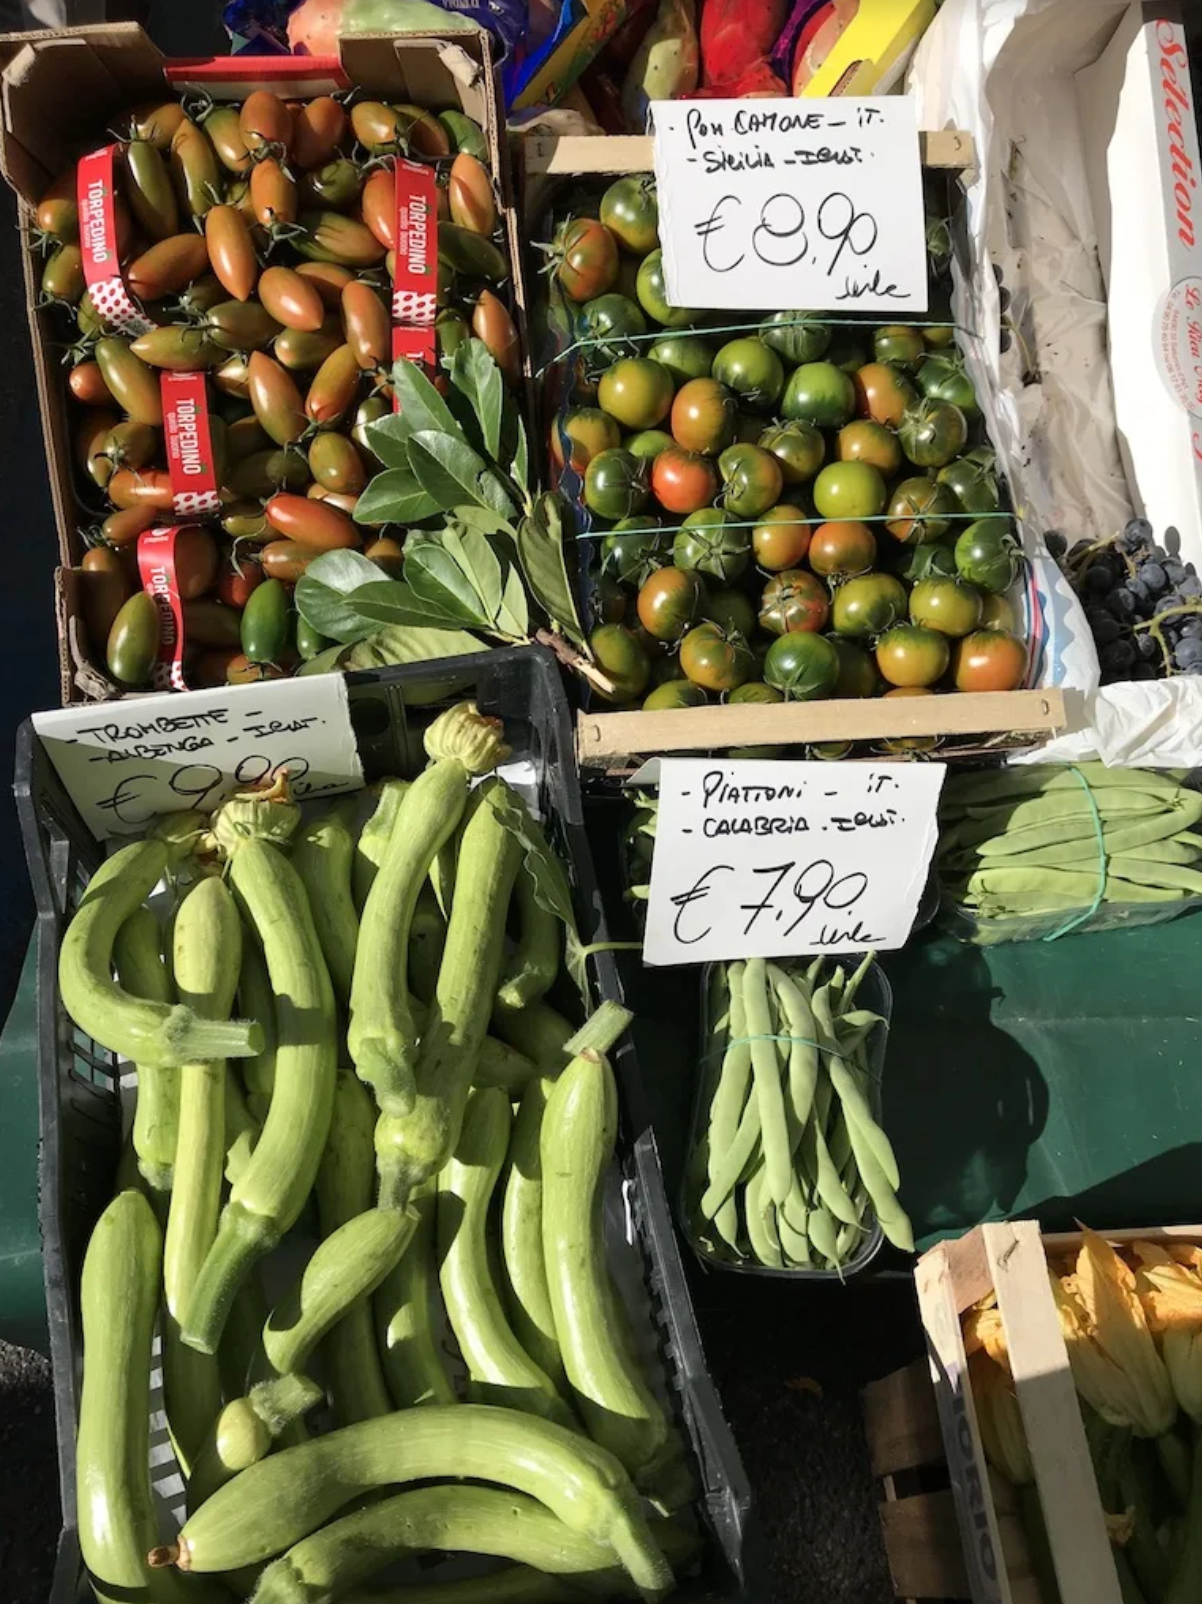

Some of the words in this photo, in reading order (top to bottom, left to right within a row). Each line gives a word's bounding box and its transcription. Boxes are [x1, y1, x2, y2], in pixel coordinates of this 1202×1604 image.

[1155, 18, 1197, 252] Selection
[87, 179, 107, 263] TORPEDINO
[408, 194, 426, 275] TORPEDINO
[175, 398, 202, 475] TORPEDINO
[77, 708, 229, 744] TROMBETTE
[703, 771, 808, 809] PIATTONI
[703, 816, 810, 838] CALABRIA
